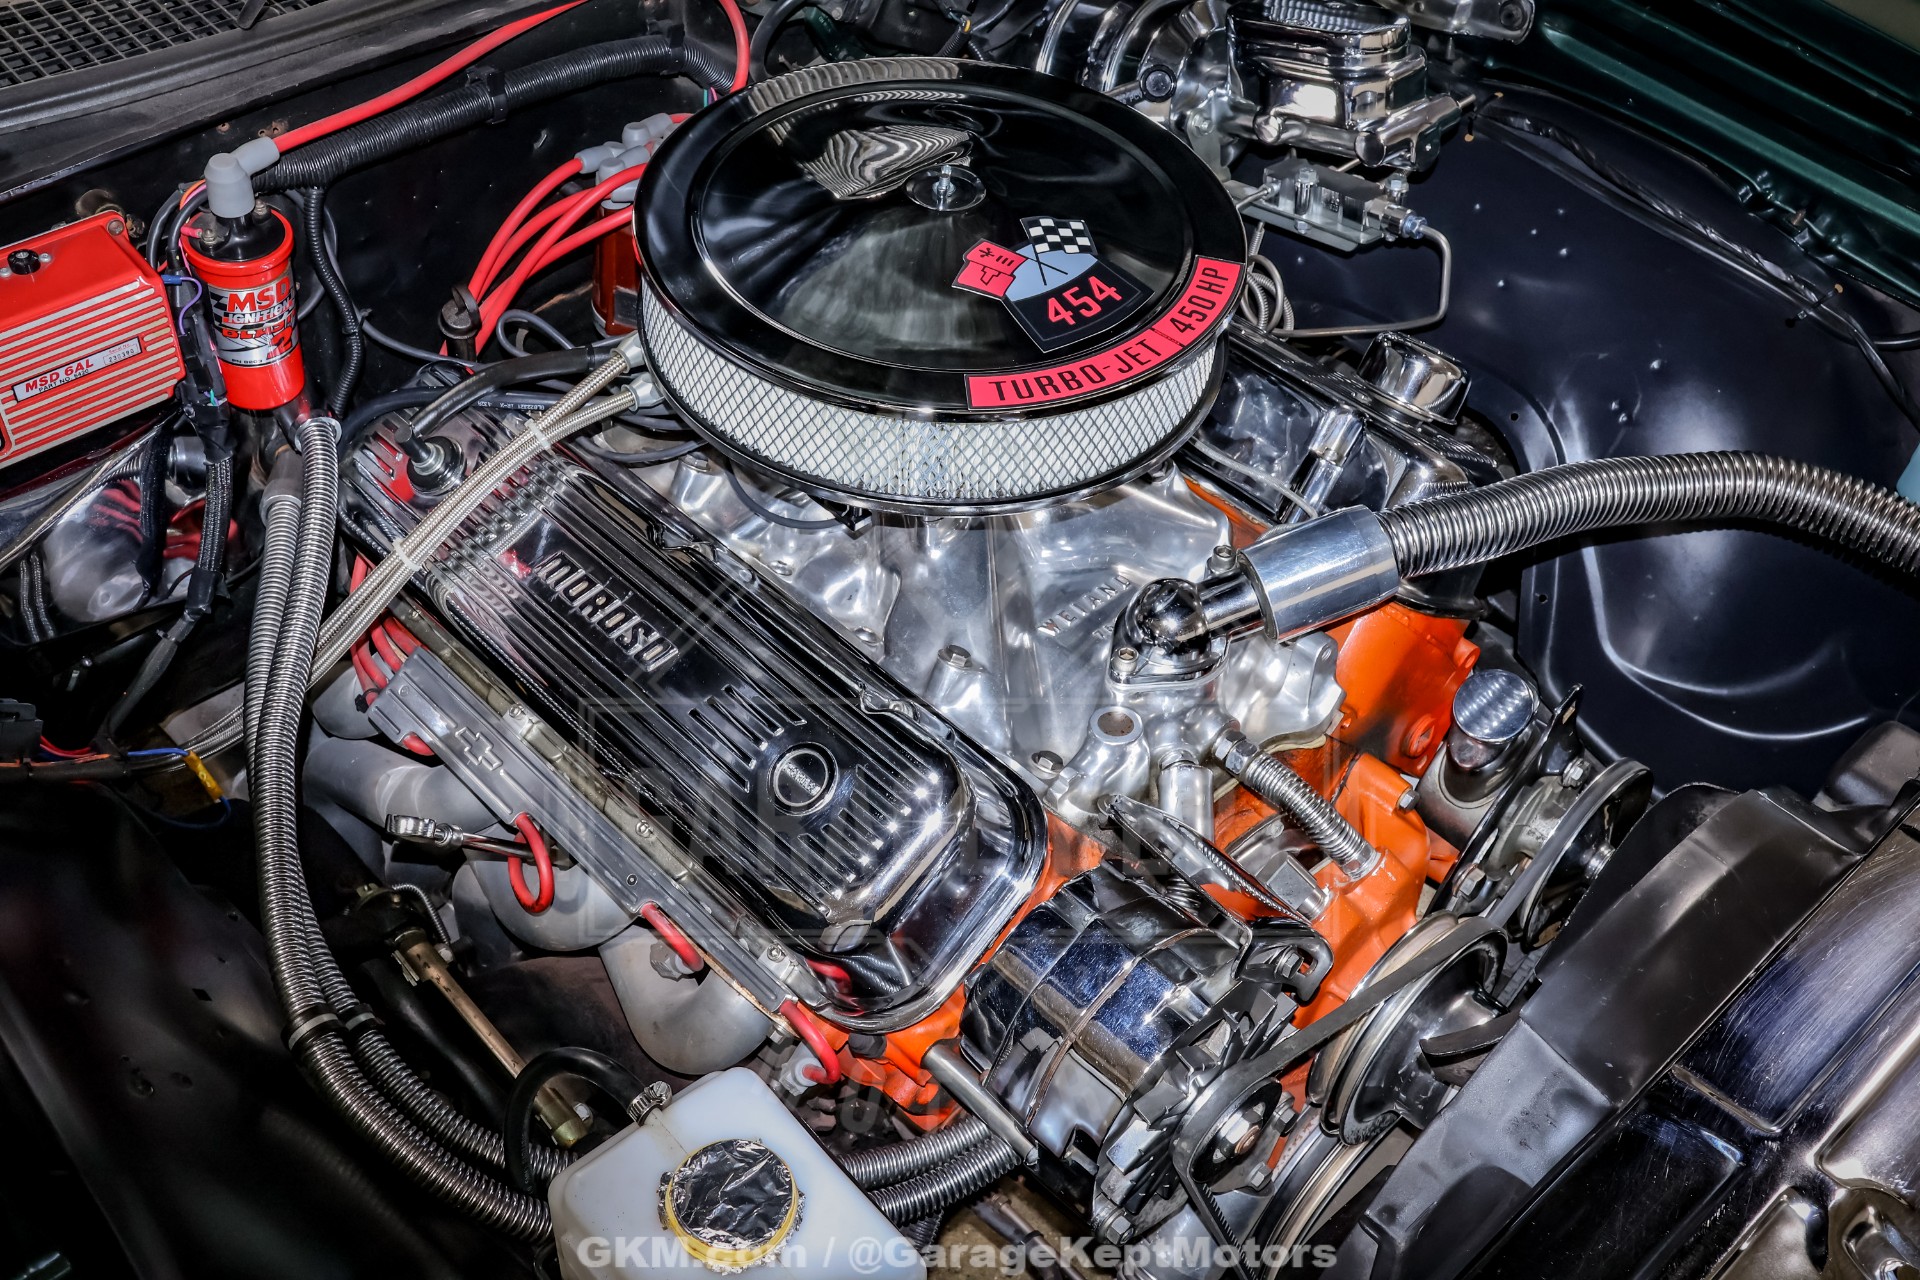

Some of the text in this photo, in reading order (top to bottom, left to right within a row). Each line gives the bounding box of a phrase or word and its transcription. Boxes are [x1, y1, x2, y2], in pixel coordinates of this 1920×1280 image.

[227, 276, 291, 312] MSD
[228, 298, 290, 323] IGNITION
[1047, 275, 1122, 326] 454
[266, 326, 293, 360] 2
[988, 266, 1229, 401] TURBO-JET 450 HP
[25, 358, 94, 392] MSD 6AL
[38, 382, 58, 393] PART
[532, 550, 679, 672] MOROSO
[1037, 575, 1131, 637] WEIAND
